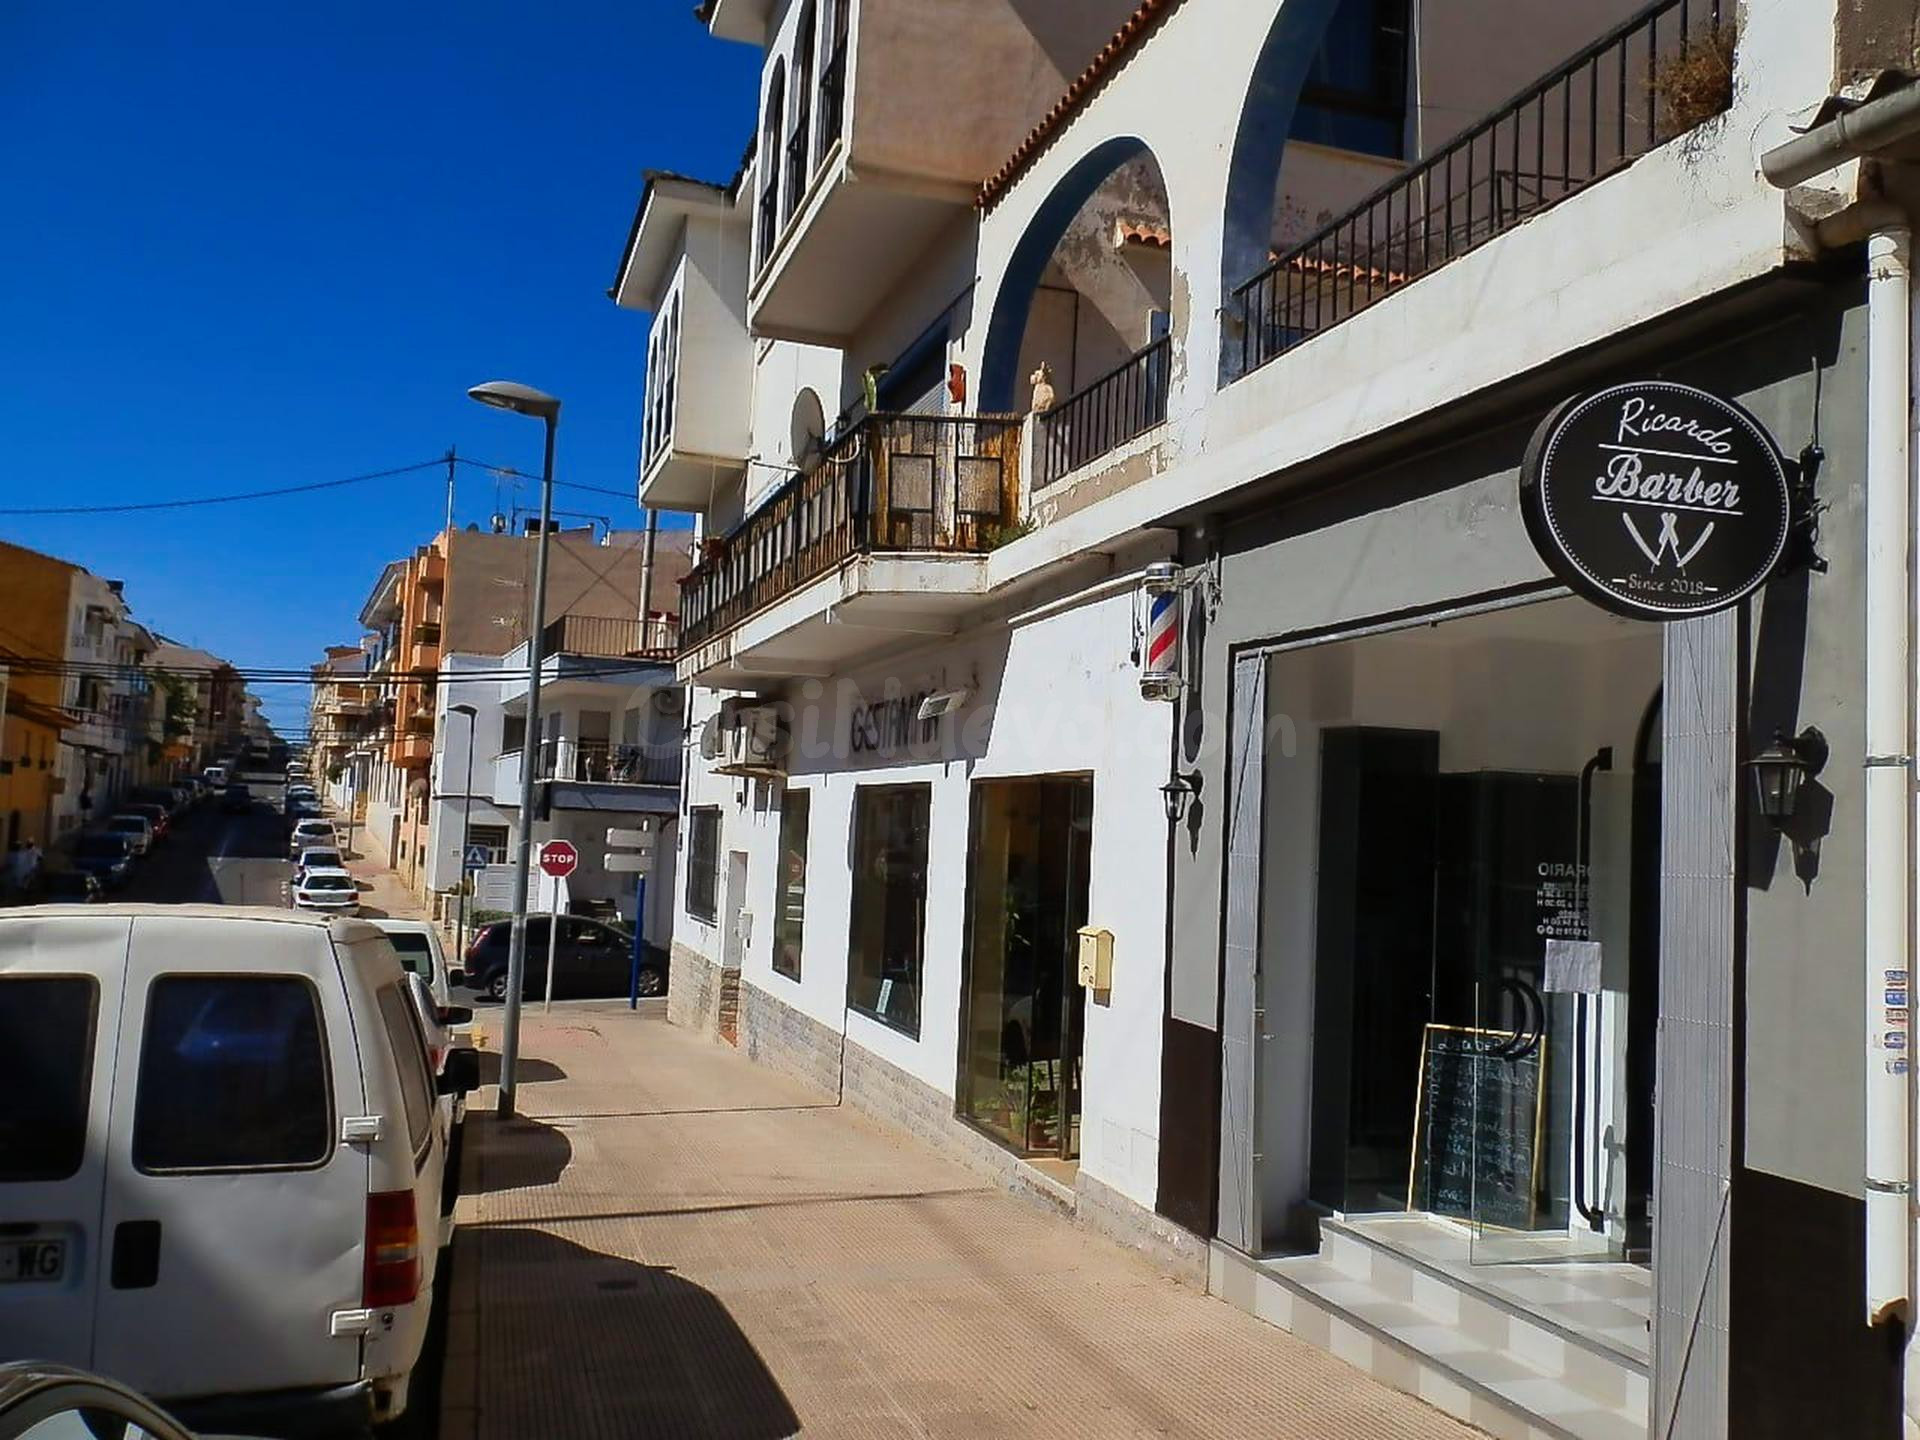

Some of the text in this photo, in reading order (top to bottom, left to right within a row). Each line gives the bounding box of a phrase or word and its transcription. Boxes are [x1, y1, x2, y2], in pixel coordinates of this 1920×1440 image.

[1617, 397, 1733, 453] Ricardo
[1595, 453, 1740, 508] Barber
[1628, 573, 1704, 595] Since 2018
[543, 853, 574, 864] STOP
